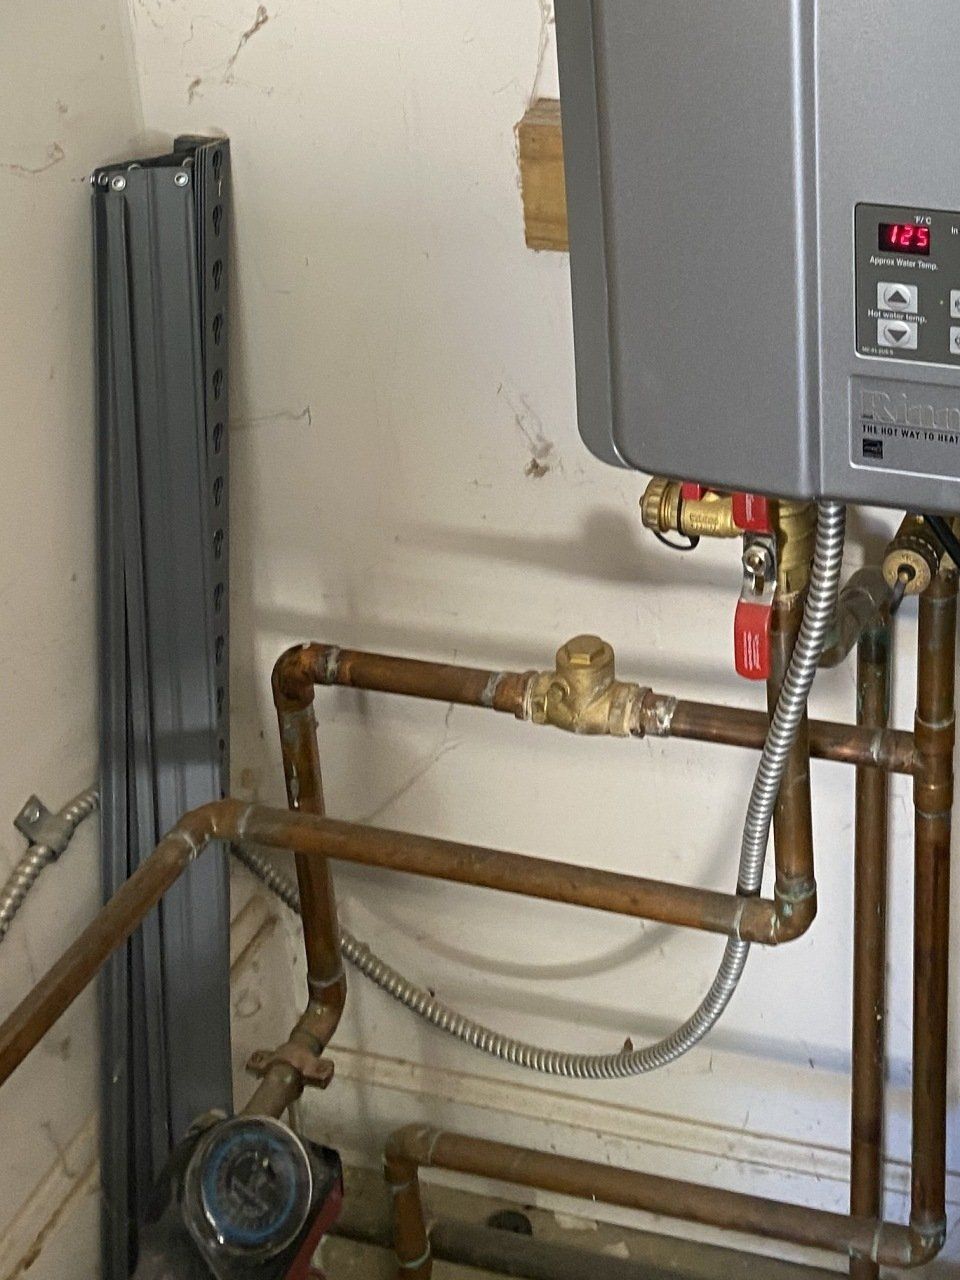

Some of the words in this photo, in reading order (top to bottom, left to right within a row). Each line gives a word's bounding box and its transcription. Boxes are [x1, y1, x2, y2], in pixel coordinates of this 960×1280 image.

[890, 225, 929, 247] 125
[951, 226, 959, 235] In
[870, 255, 895, 267] Approx
[896, 258, 916, 269] Water
[918, 260, 938, 271] Temp.
[868, 309, 881, 318] Hot
[882, 311, 904, 320] water
[862, 424, 877, 434] THE
[881, 426, 898, 437] HOT
[901, 428, 921, 440] WAY
[924, 431, 935, 441] TO
[938, 433, 959, 445] HEAT
